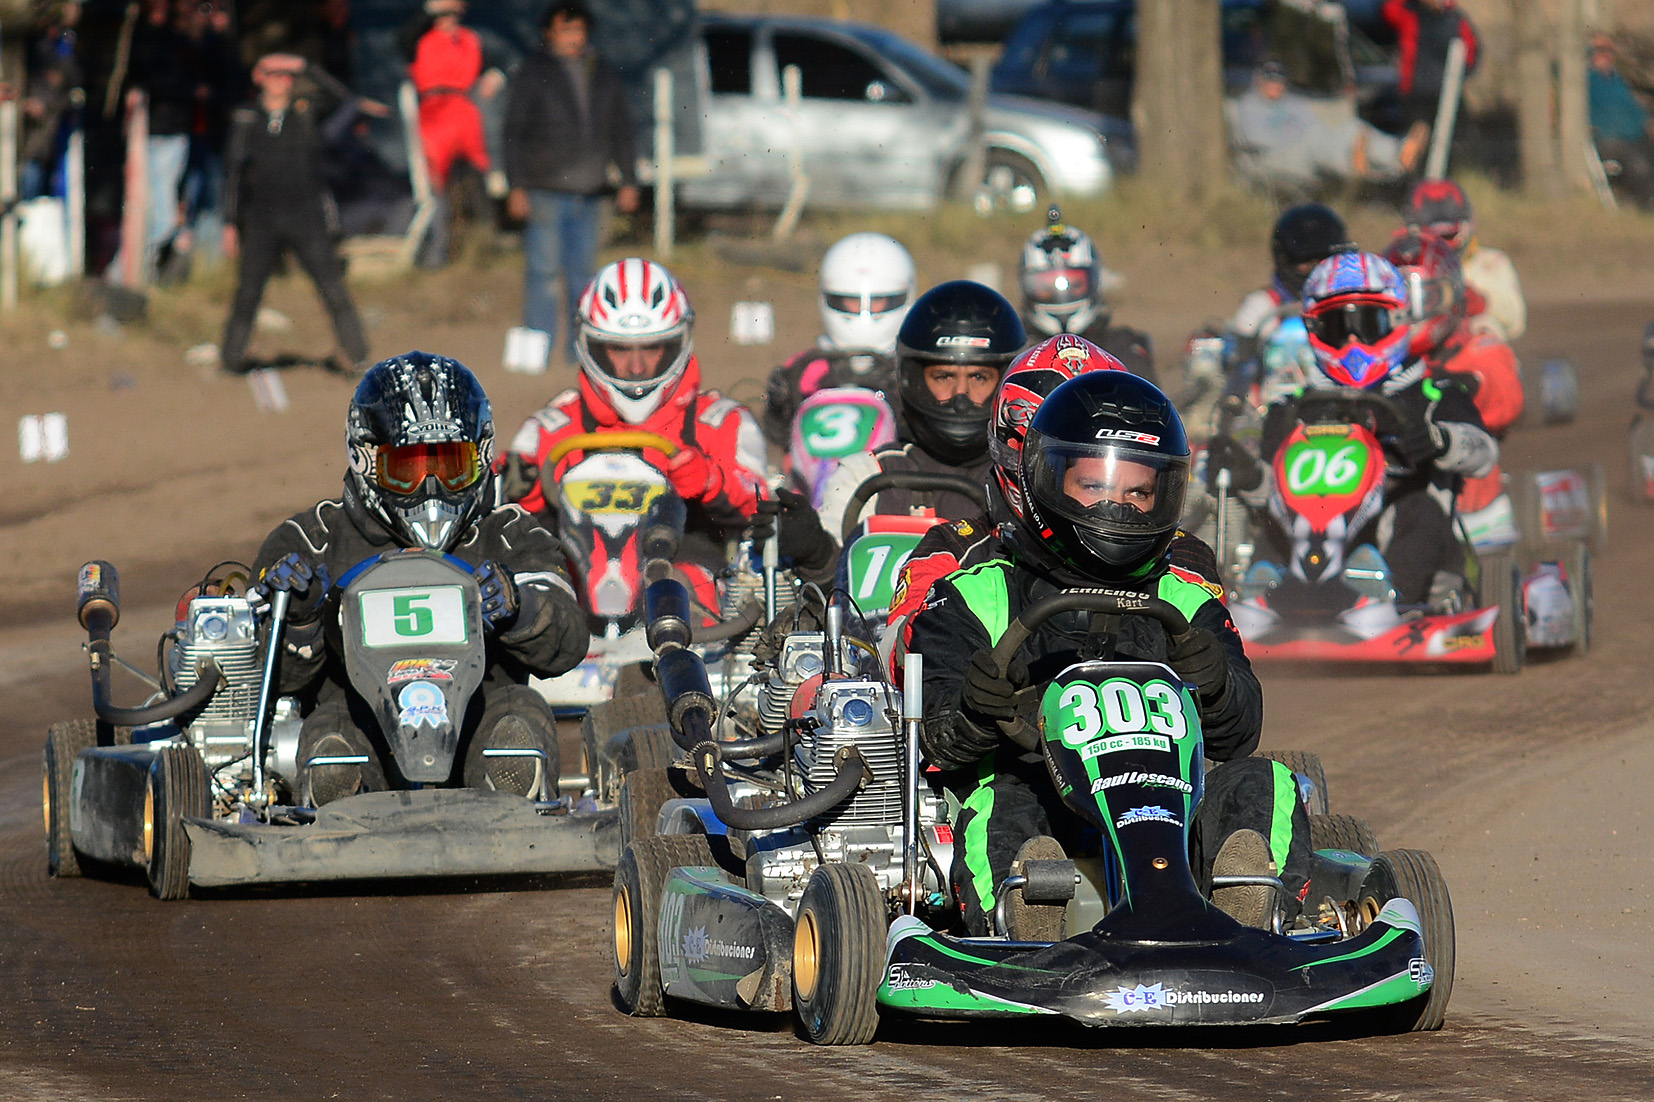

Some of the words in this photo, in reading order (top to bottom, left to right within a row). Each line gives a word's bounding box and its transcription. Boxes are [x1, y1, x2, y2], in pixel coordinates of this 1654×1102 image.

[808, 404, 862, 450] 3
[1289, 445, 1358, 492] 06
[582, 482, 651, 510] 33
[393, 594, 434, 637] 5
[1116, 598, 1143, 609] Kart
[1059, 681, 1188, 746] 303
[1088, 742, 1107, 756] 150
[1110, 739, 1123, 748] cc
[1132, 736, 1151, 747] 185
[1153, 737, 1166, 750] kg
[1090, 772, 1131, 795] Raul
[1128, 771, 1193, 794] Lescano
[1166, 990, 1265, 1005] Distribuciones
